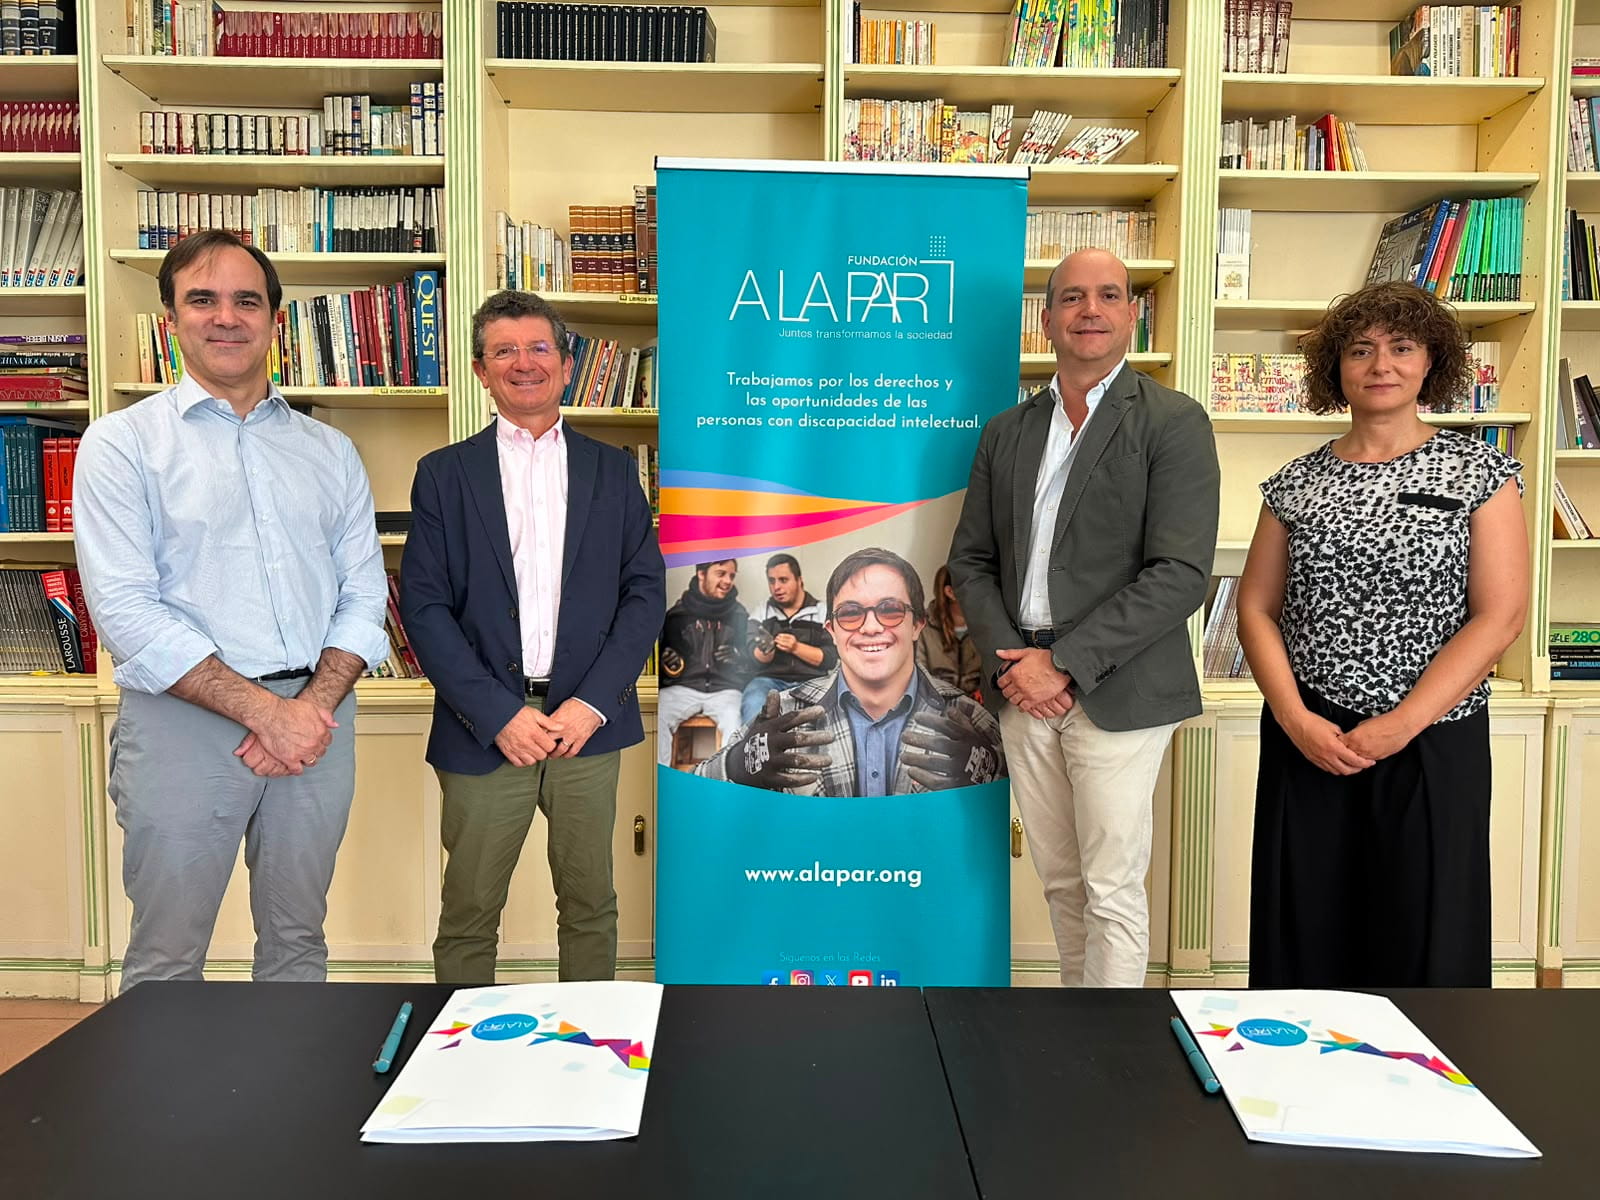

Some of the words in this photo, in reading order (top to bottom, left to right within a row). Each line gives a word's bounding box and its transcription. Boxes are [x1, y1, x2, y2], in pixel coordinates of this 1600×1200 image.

[847, 255, 918, 266] FUNDACIÓN
[729, 270, 929, 323] ALAPAR
[417, 274, 436, 361] QUEST
[779, 328, 813, 338] Juntos
[816, 329, 891, 339] transformamos
[895, 329, 903, 339] la
[907, 330, 952, 340] sociedad
[727, 372, 813, 388] Trabajamos
[819, 376, 843, 389] por
[850, 372, 868, 388] los
[874, 373, 939, 388] derechos
[945, 378, 953, 391] y
[746, 392, 766, 406] las
[772, 394, 878, 409] oportunidades
[883, 394, 901, 408] de
[907, 395, 927, 408] las
[696, 415, 763, 428] personas
[768, 417, 792, 427] con
[798, 414, 896, 429] discapacidad
[901, 415, 981, 429] intelectual.
[57, 617, 76, 669] LAROUSSE
[744, 861, 922, 888] www.alapar.ong
[823, 954, 834, 962] en
[837, 951, 850, 962] las
[853, 951, 881, 962] Redes
